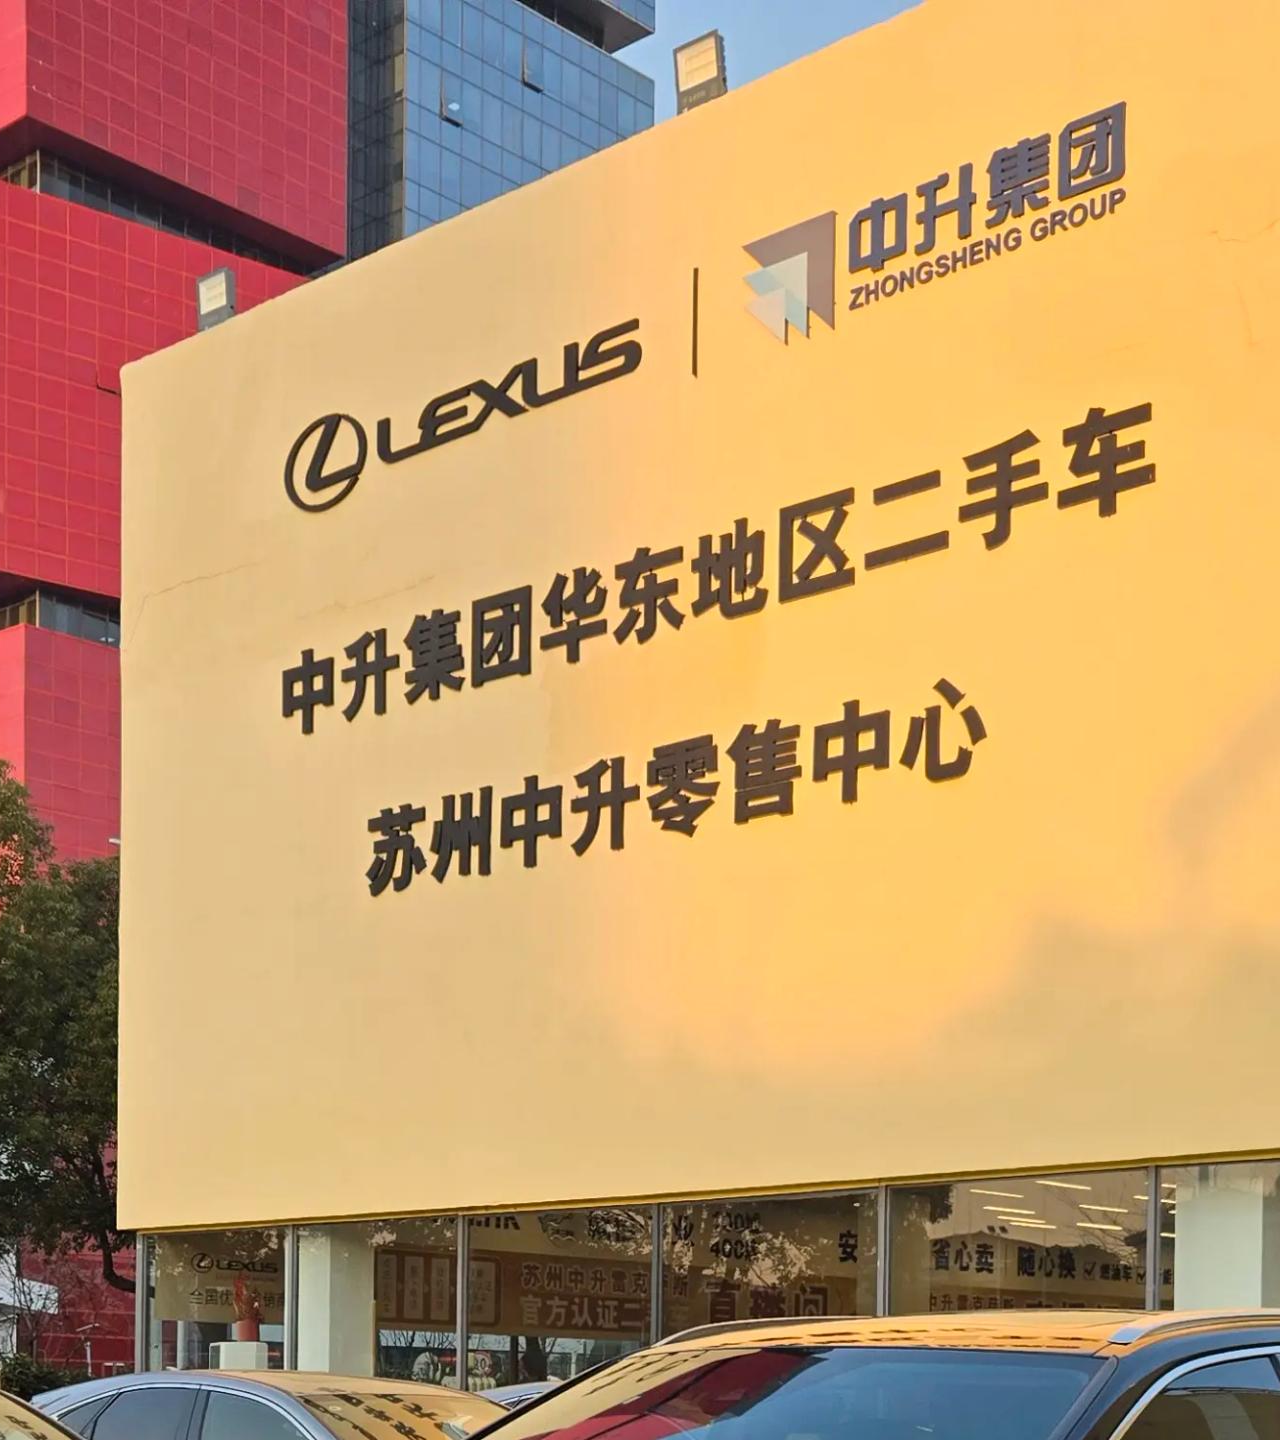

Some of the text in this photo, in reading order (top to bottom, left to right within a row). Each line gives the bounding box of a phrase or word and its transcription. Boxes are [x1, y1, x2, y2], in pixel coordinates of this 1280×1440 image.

[847, 100, 1128, 273] 中升集团
[849, 187, 1128, 311] ZHONGSHENG GROUP
[376, 317, 643, 464] LEXUS
[281, 401, 1157, 735] 中升集团华东地区二手车
[365, 677, 988, 897] 苏州中升零售中心
[215, 1259, 278, 1274] LEXUS
